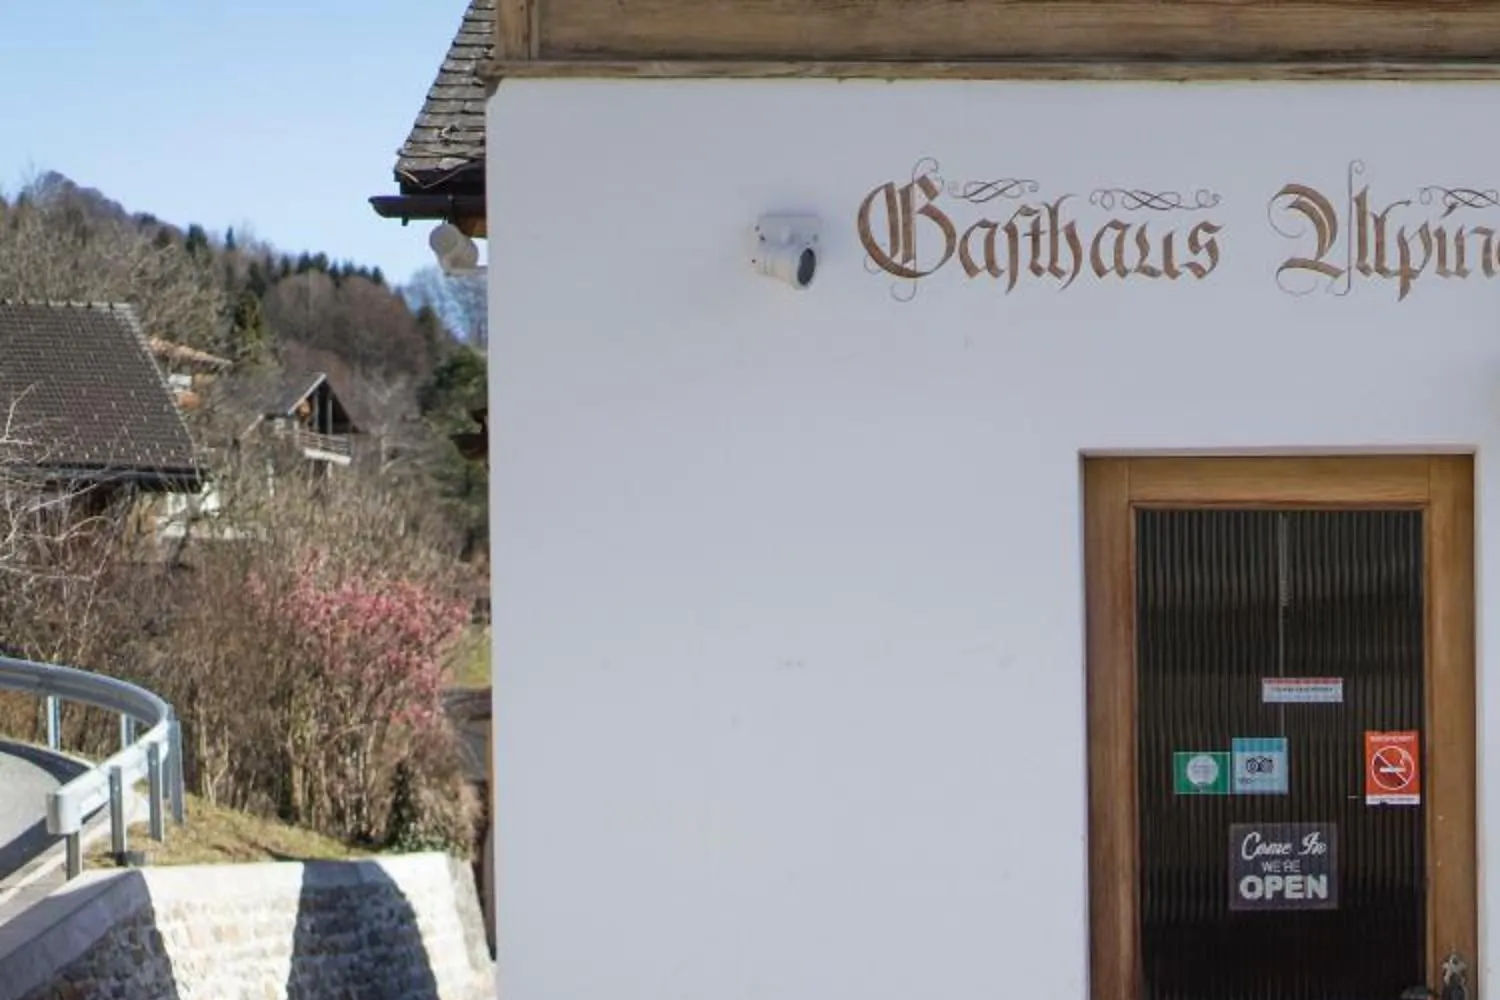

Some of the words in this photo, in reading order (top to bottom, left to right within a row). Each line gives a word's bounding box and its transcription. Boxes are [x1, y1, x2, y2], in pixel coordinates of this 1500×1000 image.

[857, 157, 1224, 301] Gasthaus
[1241, 831, 1292, 860] Come
[1239, 874, 1328, 899] OPEN
